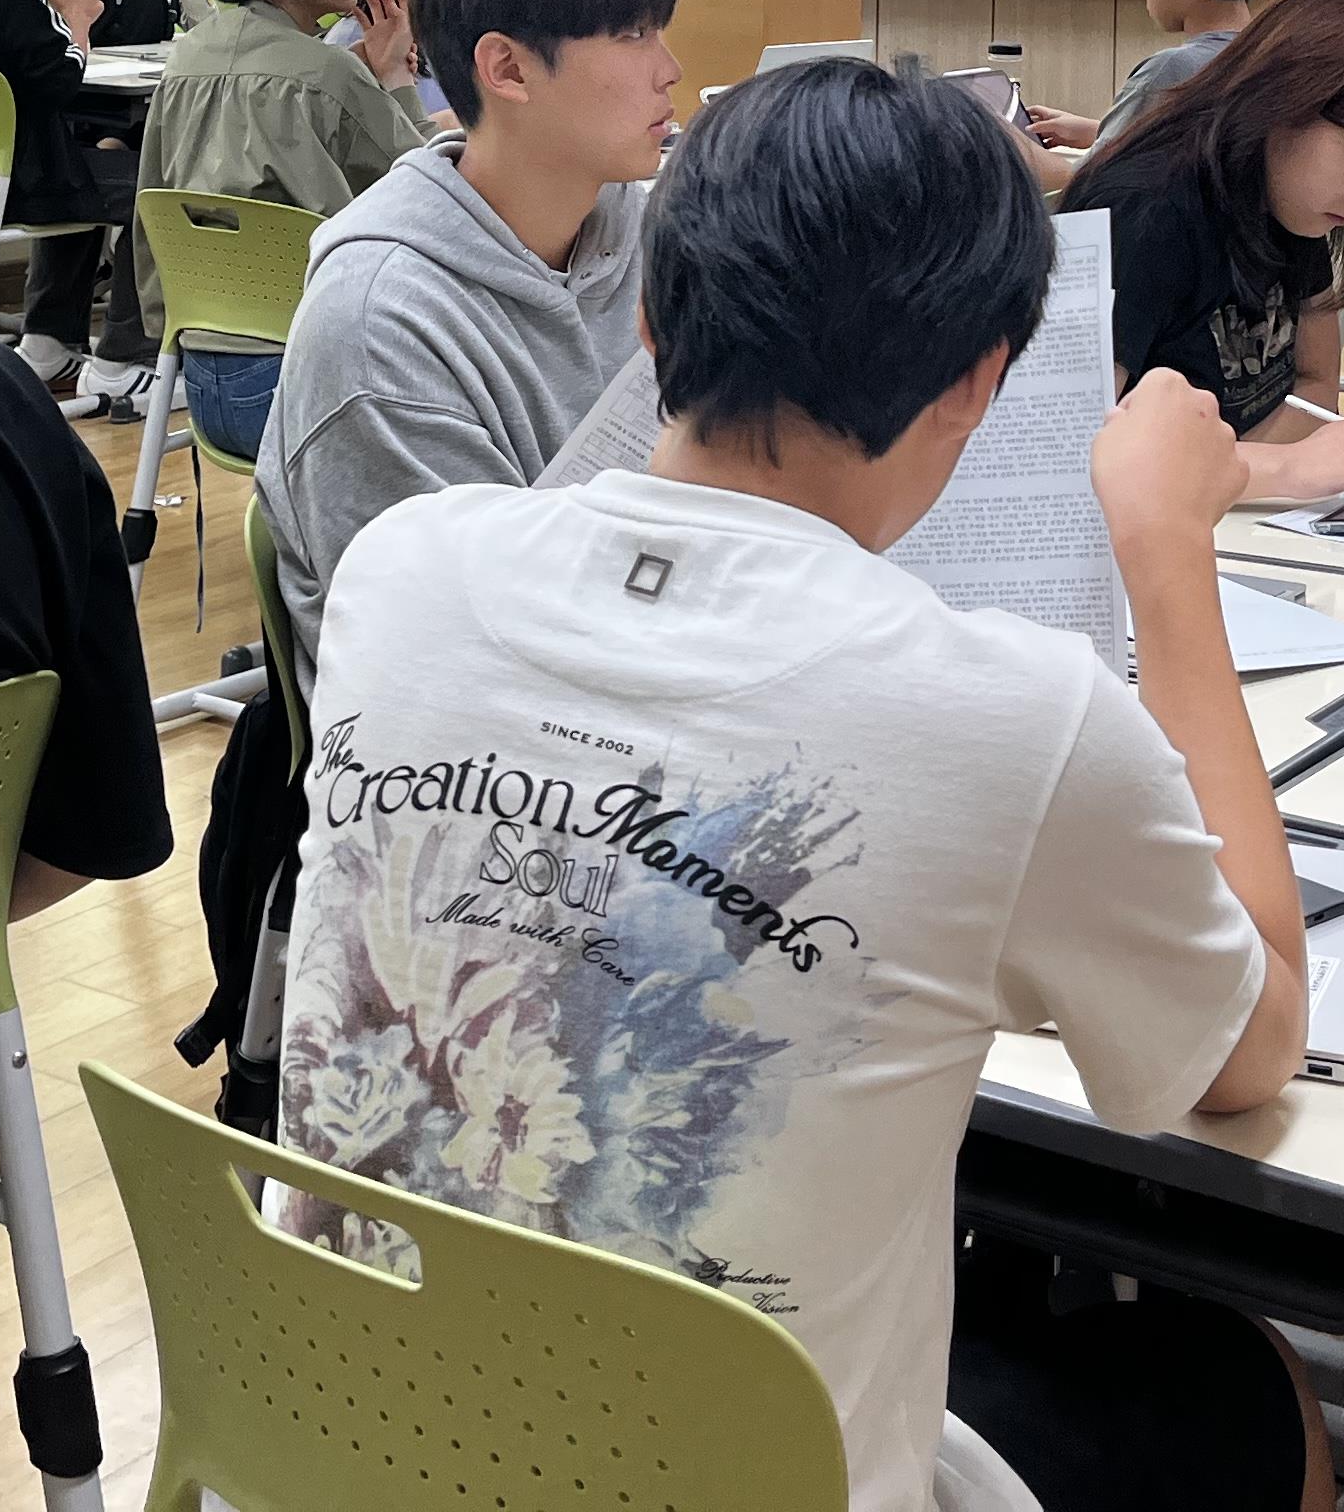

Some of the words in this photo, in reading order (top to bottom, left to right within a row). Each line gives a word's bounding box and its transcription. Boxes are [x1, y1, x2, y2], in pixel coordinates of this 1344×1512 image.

[314, 712, 363, 780] The
[539, 720, 592, 744] SINCE
[595, 737, 636, 757] 2002
[326, 752, 575, 831] Creation
[575, 783, 860, 973] Moments
[479, 819, 620, 918] Soul
[425, 892, 503, 929] Made
[509, 922, 576, 948] with
[580, 927, 636, 986] Care
[695, 1257, 792, 1286] Productive
[752, 1292, 801, 1315] Vision
